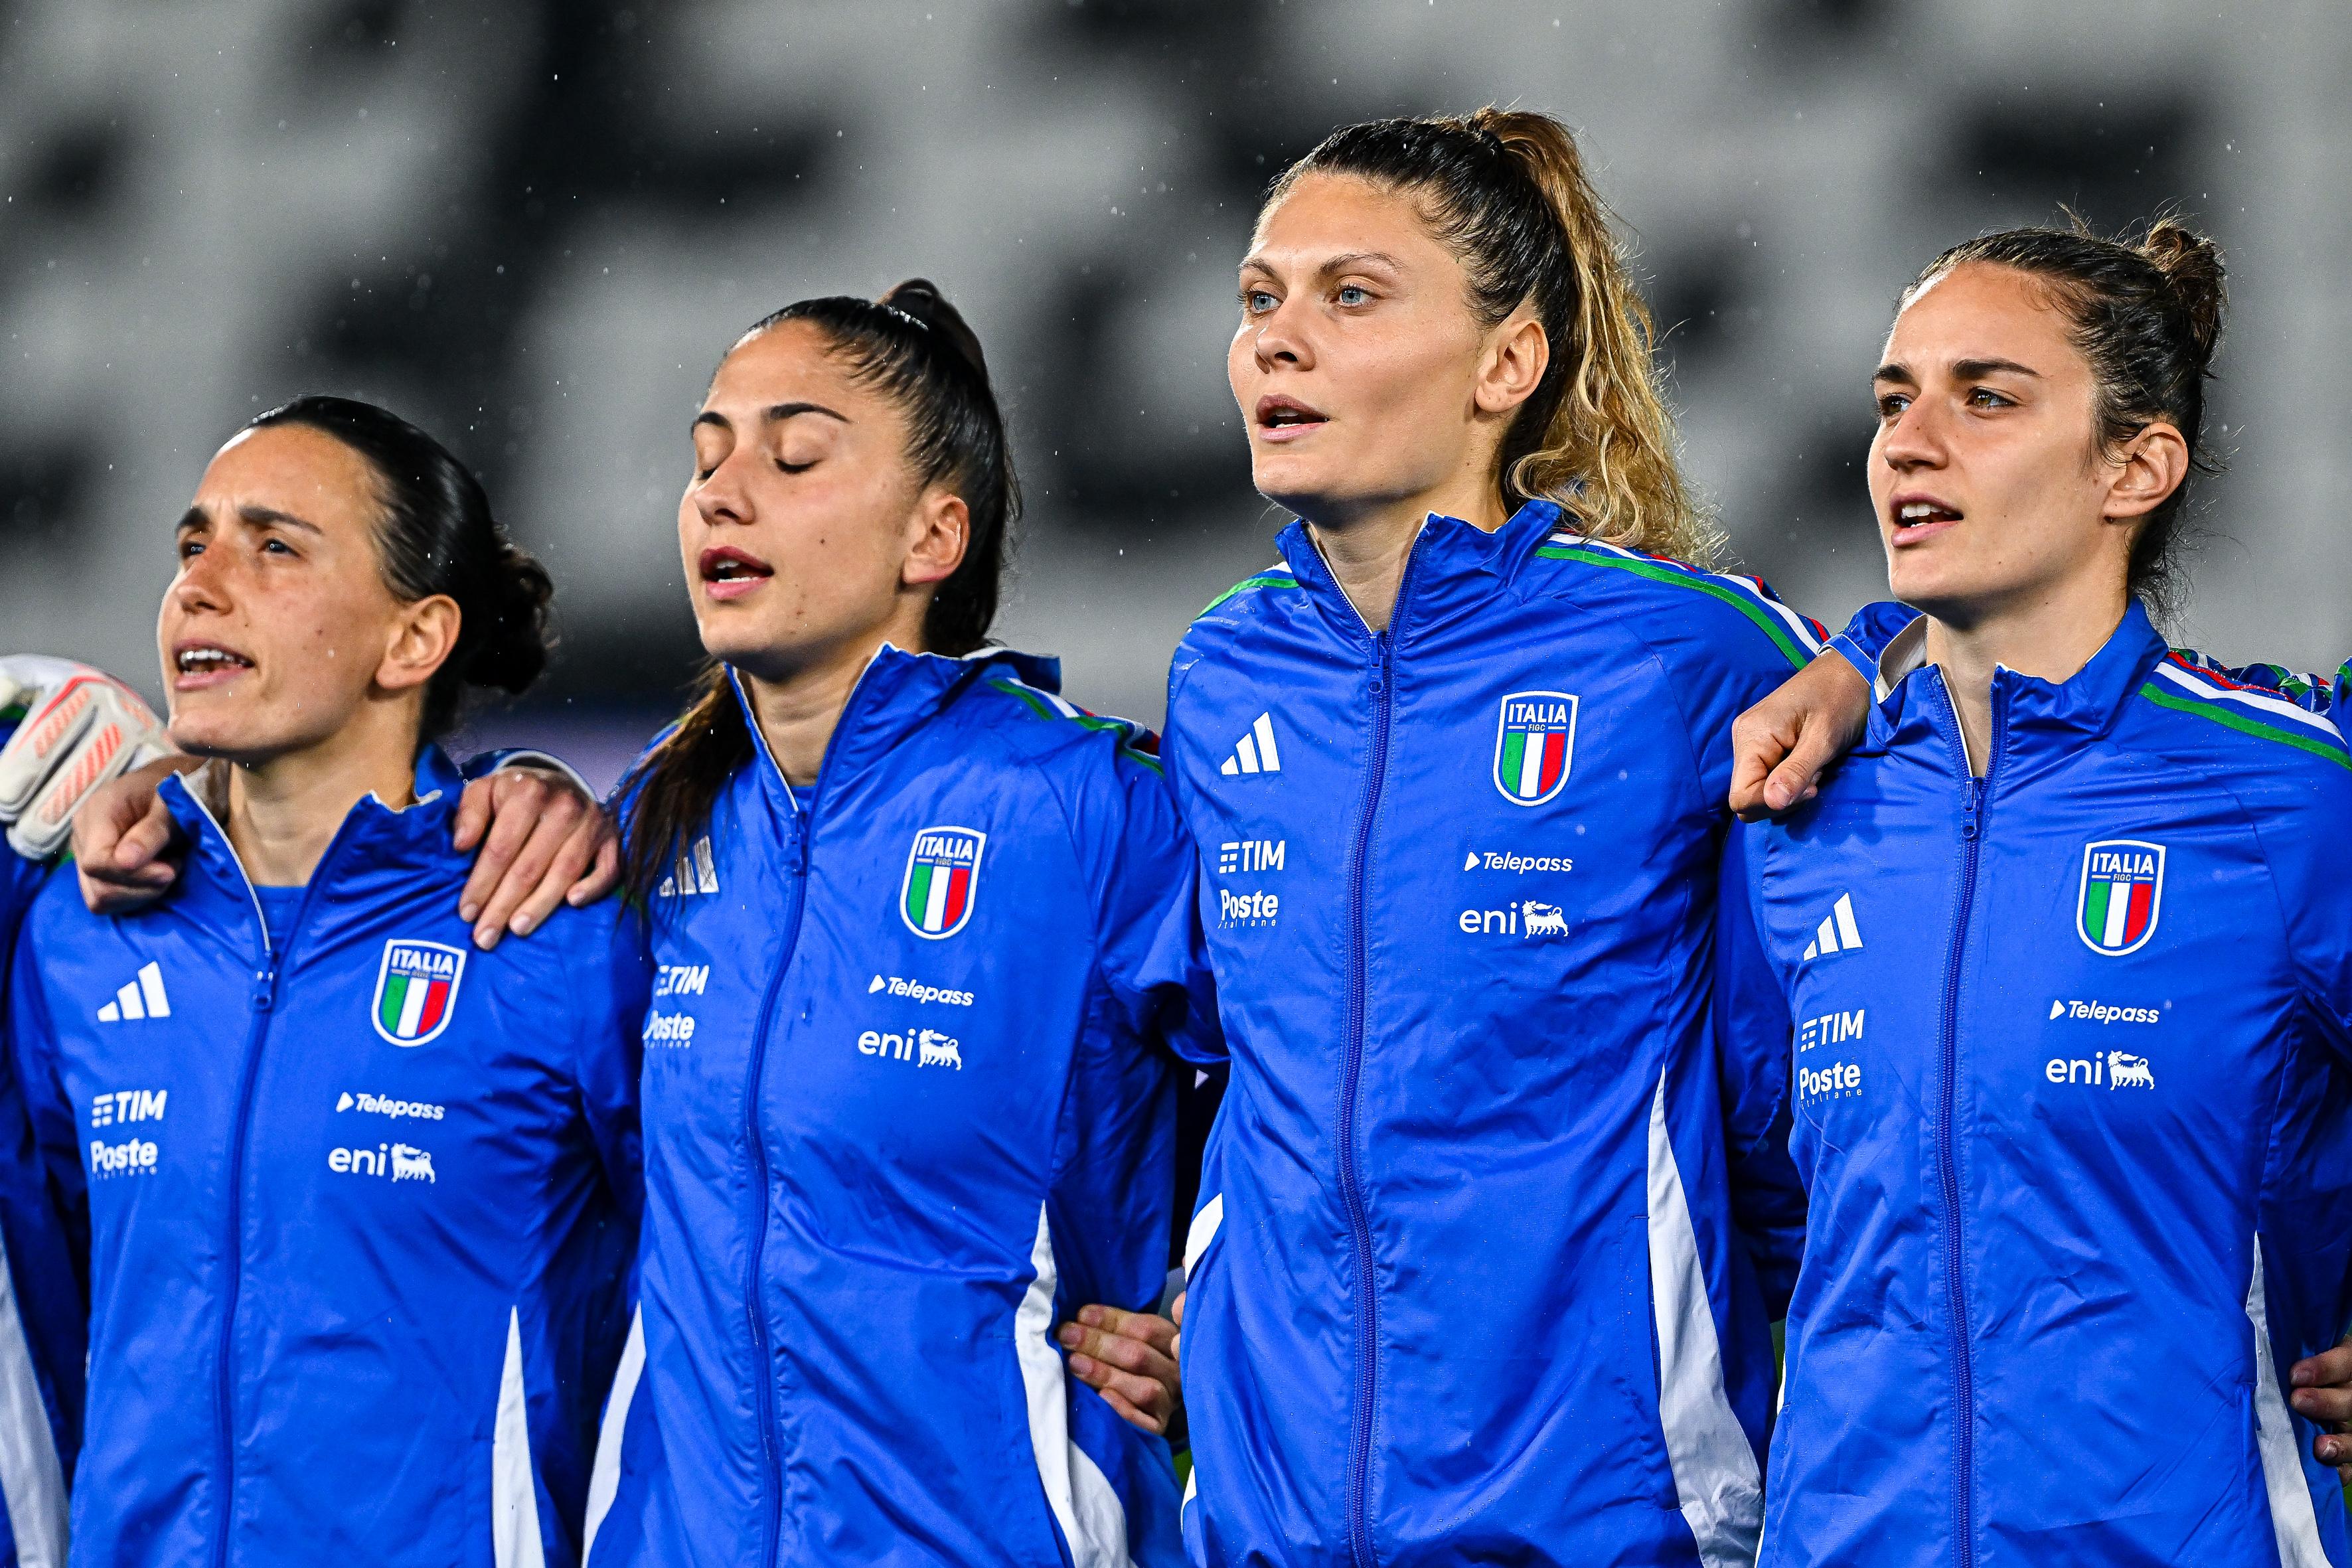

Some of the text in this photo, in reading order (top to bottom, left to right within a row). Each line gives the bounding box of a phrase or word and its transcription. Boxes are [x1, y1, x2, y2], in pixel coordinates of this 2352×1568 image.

[1508, 704, 1567, 723] ITALIA
[917, 836, 973, 860] ITALIA
[1241, 840, 1286, 872] TIM
[1483, 851, 1573, 875] Telepass
[2092, 853, 2155, 874] ITALIA
[1220, 889, 1279, 921] Poste
[1459, 902, 1518, 935] eni
[1217, 918, 1277, 929] italiane
[390, 947, 454, 974] ITALIA
[668, 965, 710, 995] TIM
[887, 977, 975, 1006] Telepass
[1820, 1009, 1865, 1046] TIM
[2068, 1000, 2160, 1025] Telepass
[858, 1028, 916, 1061] eni
[1799, 1061, 1861, 1101] Poste
[2045, 1051, 2104, 1085] eni
[115, 1089, 168, 1124] TIM
[355, 1093, 445, 1121] Telepass
[1800, 1088, 1863, 1110] italiane
[90, 1137, 159, 1174] Poste
[328, 1142, 388, 1176] eni
